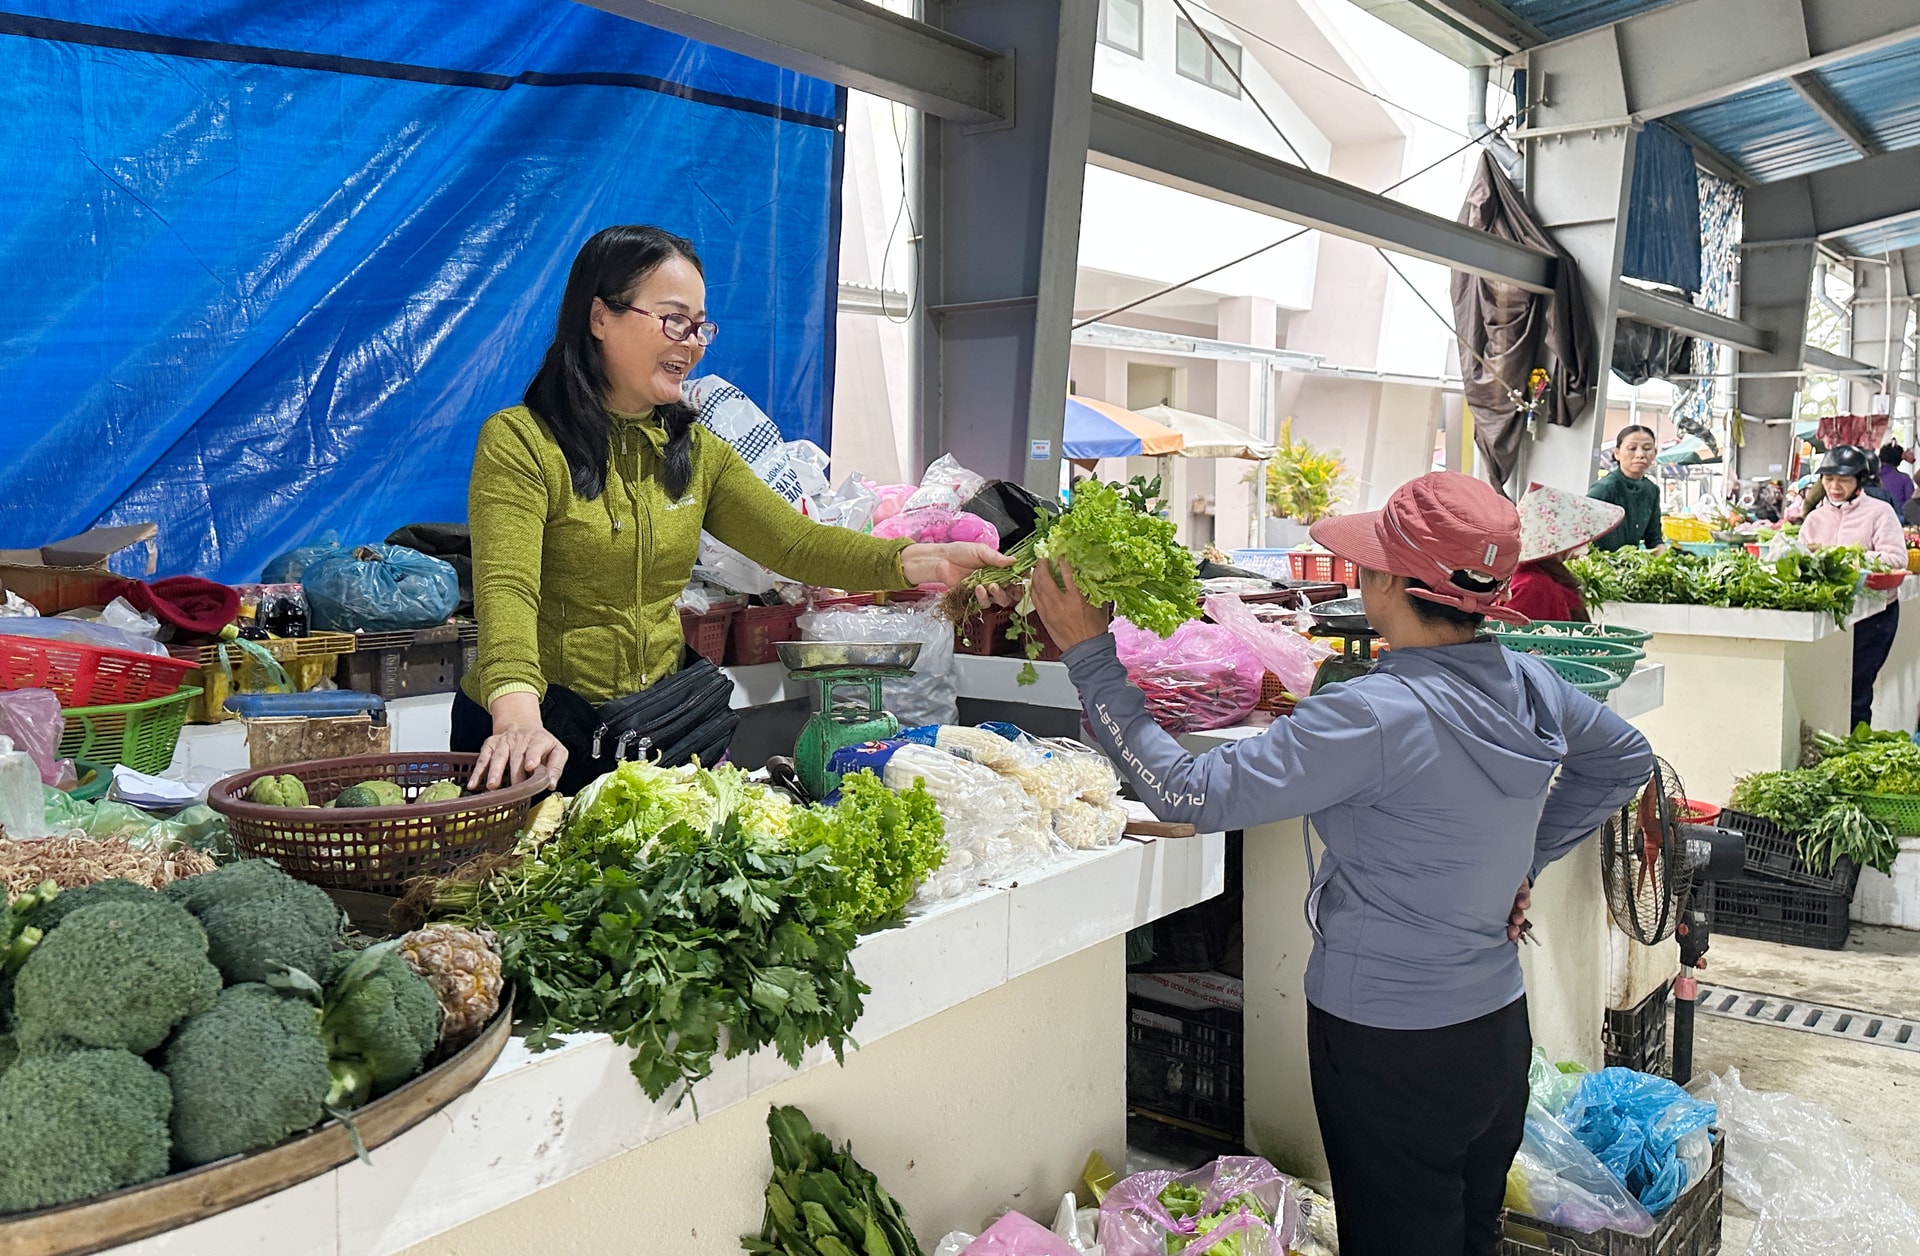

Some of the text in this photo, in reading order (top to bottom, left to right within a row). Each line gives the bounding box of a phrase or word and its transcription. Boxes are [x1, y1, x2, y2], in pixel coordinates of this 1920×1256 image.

[1095, 703, 1205, 807] PLAY YOUR BEST
